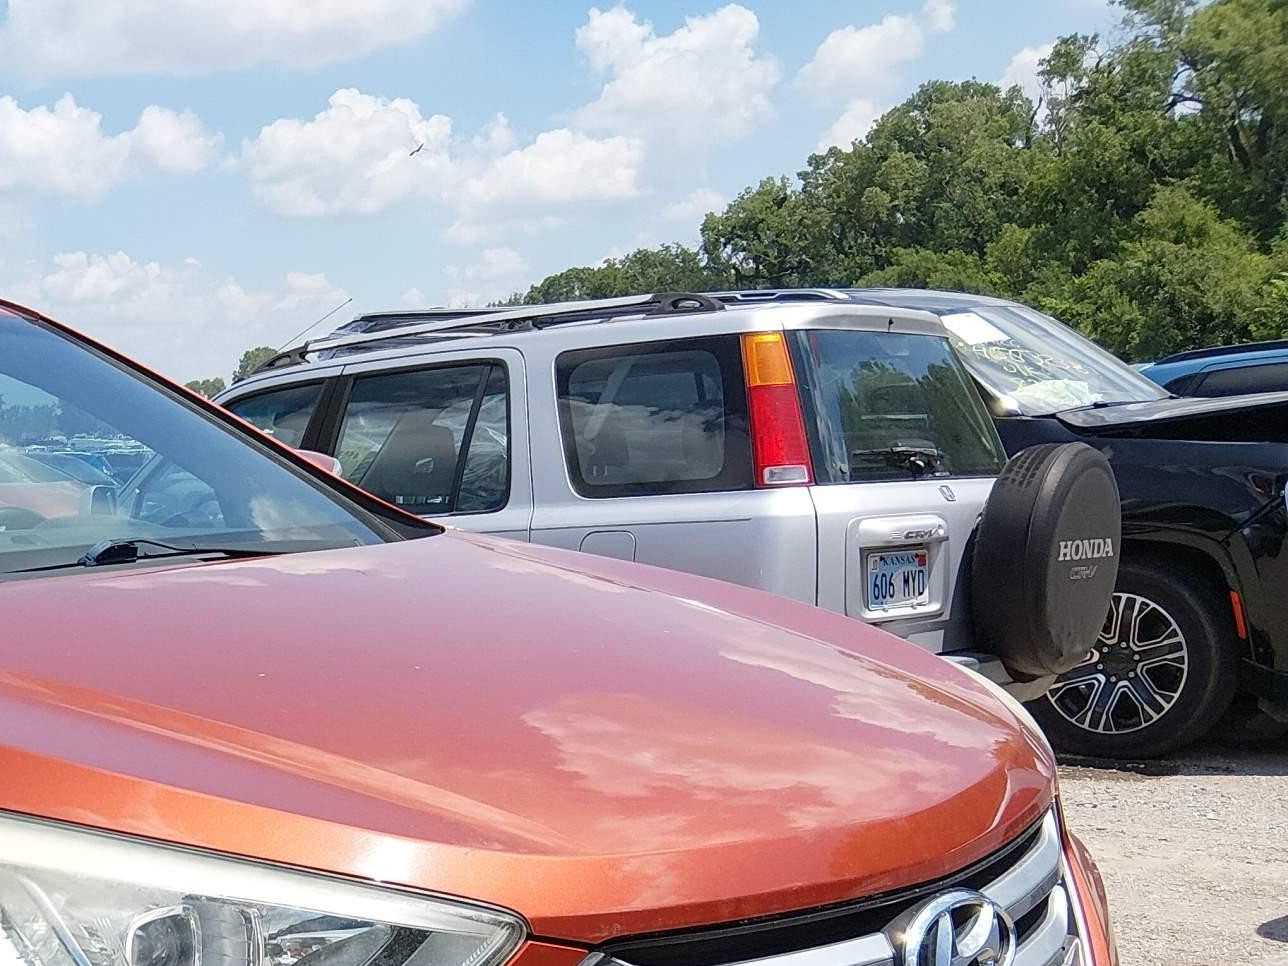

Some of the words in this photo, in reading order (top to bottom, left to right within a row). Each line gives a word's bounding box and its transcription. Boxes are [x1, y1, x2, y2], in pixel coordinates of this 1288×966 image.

[1058, 538, 1114, 561] HONDA
[873, 573, 895, 600] 606
[903, 570, 925, 598] MYD
